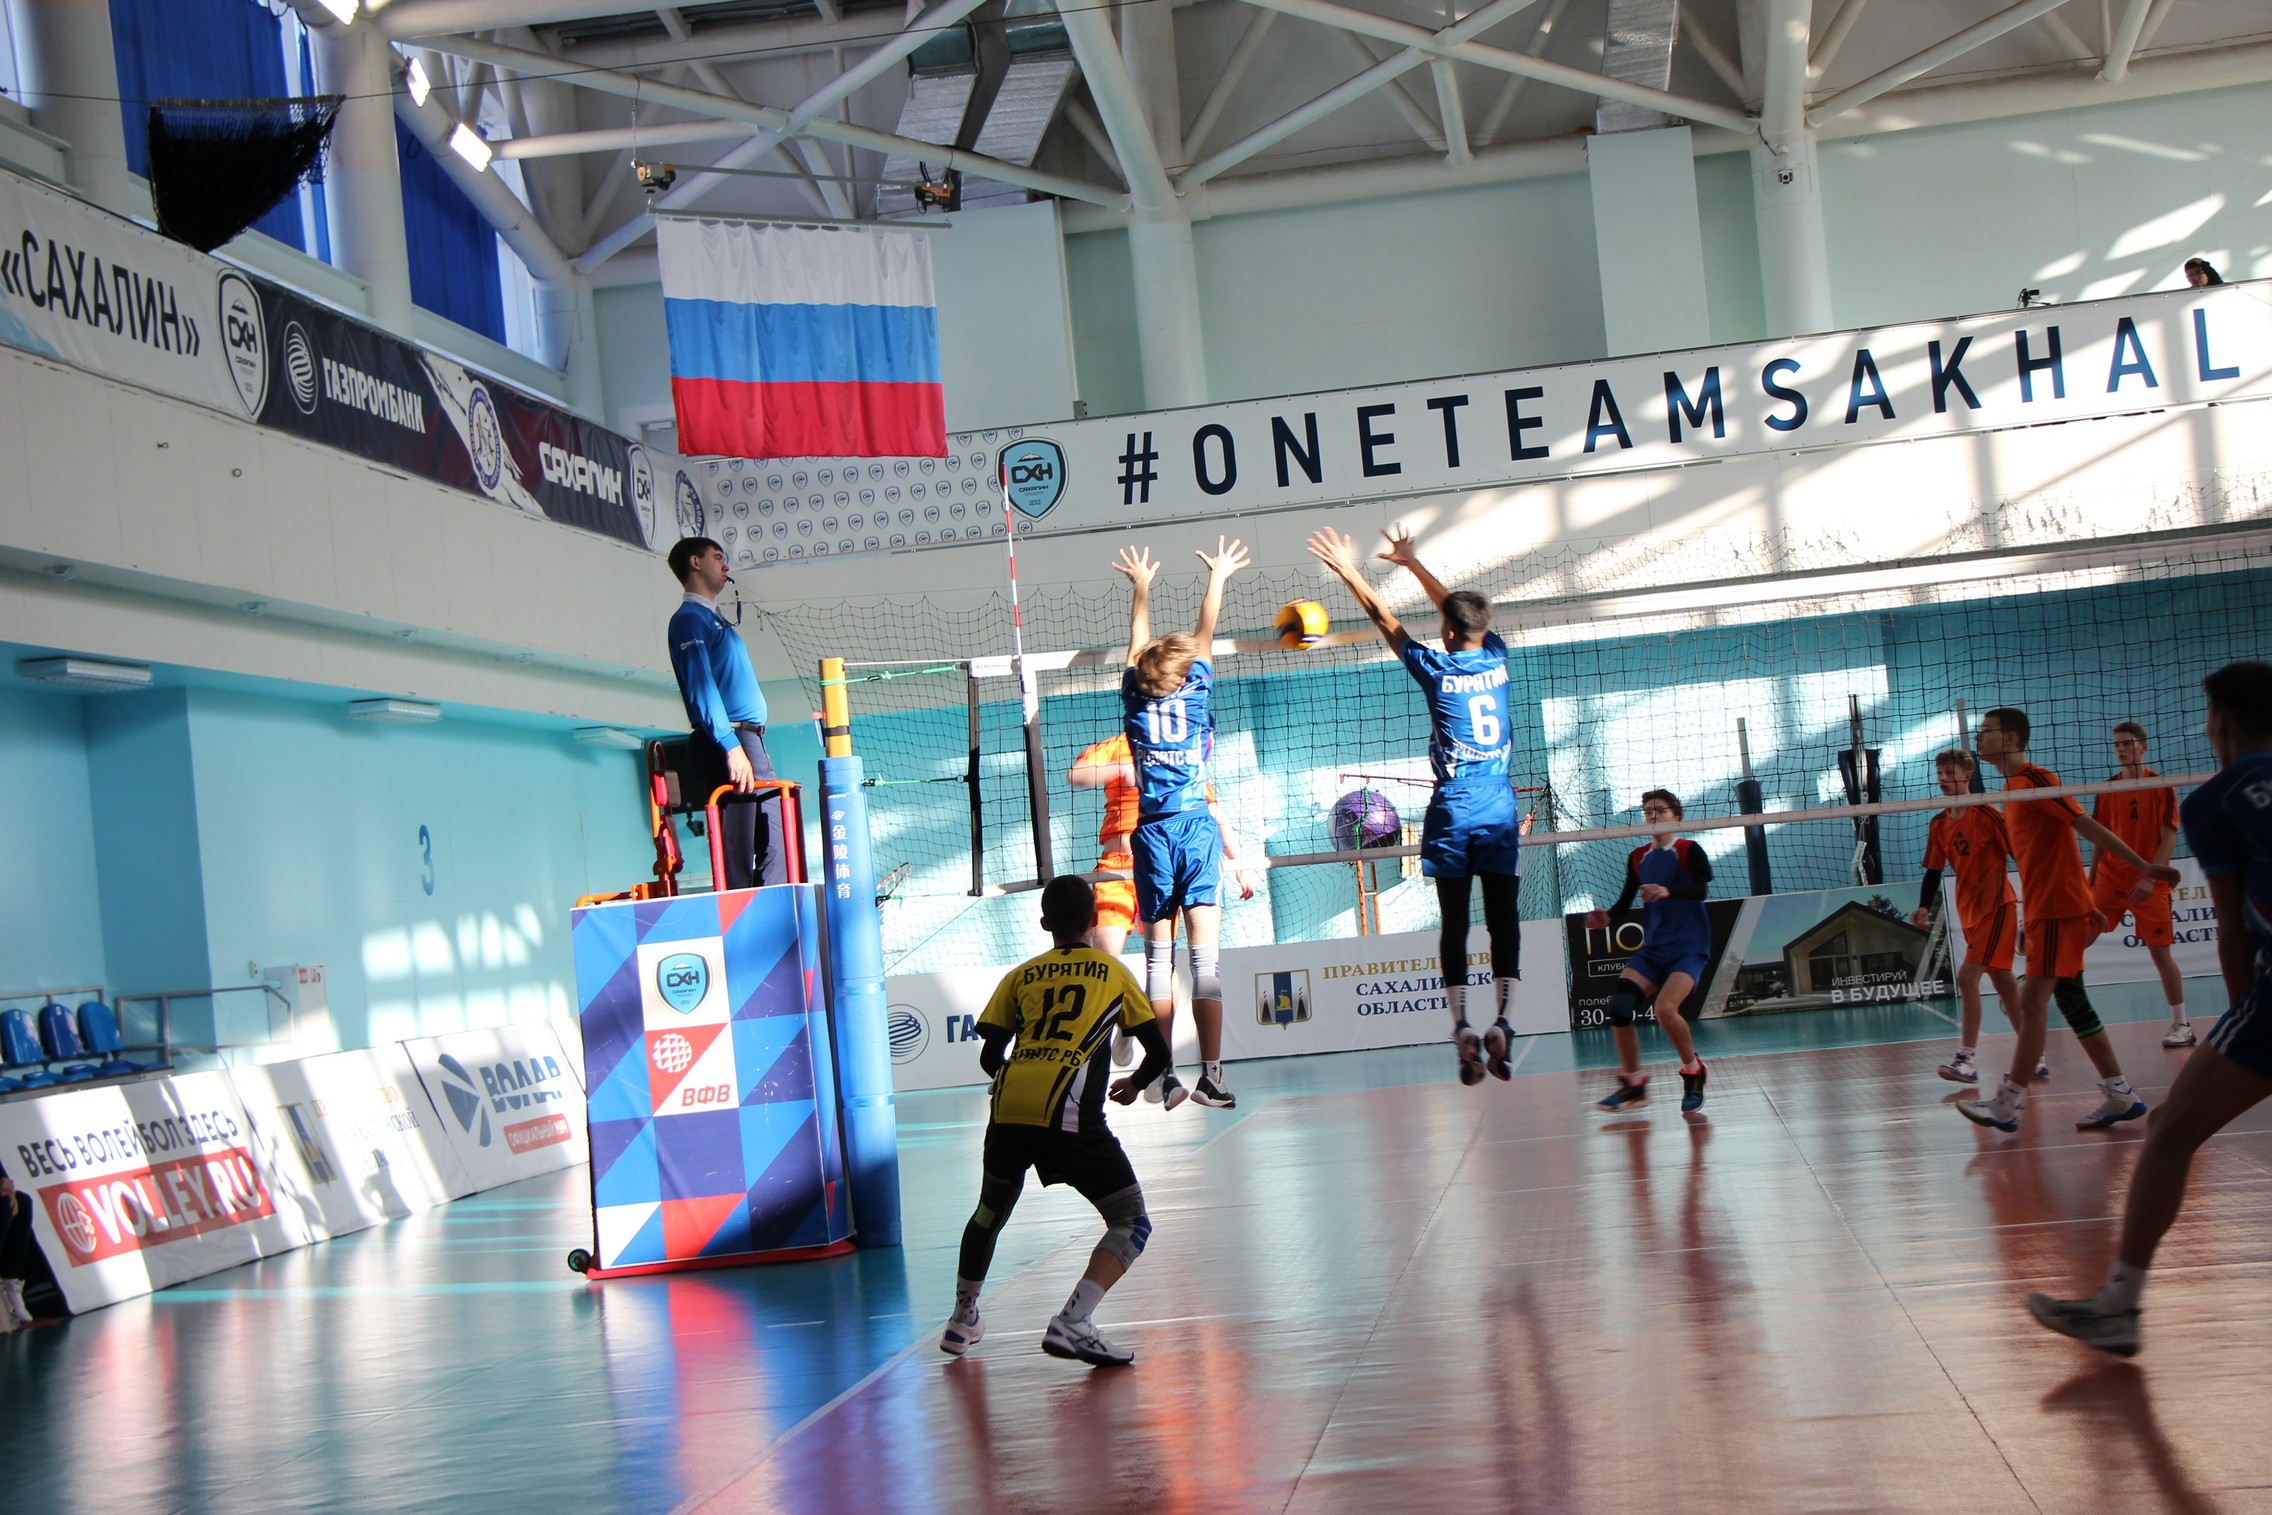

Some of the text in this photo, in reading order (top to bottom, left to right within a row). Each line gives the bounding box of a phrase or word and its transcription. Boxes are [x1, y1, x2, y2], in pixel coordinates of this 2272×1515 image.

[1, 229, 200, 357] «САХАЛИН»
[322, 356, 426, 434] ГАЗПРОМБАНК
[538, 441, 625, 507] САХАЛИН
[1011, 462, 1053, 484] СХН
[1145, 698, 1188, 744] 10
[1467, 694, 1501, 746] 6
[2130, 806, 2140, 821] 4
[419, 824, 435, 897] 3
[832, 824, 851, 899] 金陵体育
[1952, 839, 1970, 856] 12
[1023, 960, 1109, 985] БУРЯТИЯ
[1322, 951, 1492, 980] ПРАВИТЕЛТВ
[1831, 969, 1907, 987] ИНВЕСТИРУЙ
[1031, 983, 1086, 1042] 12
[1831, 979, 1945, 1003] В БУДУЩЕЕ
[681, 1084, 731, 1107] ВФВ
[17, 1109, 239, 1179] ВЕСЬ ВОЛЕЙБОЛ ЗДЕСЬ
[81, 1155, 262, 1244] VOLLEY.RU
